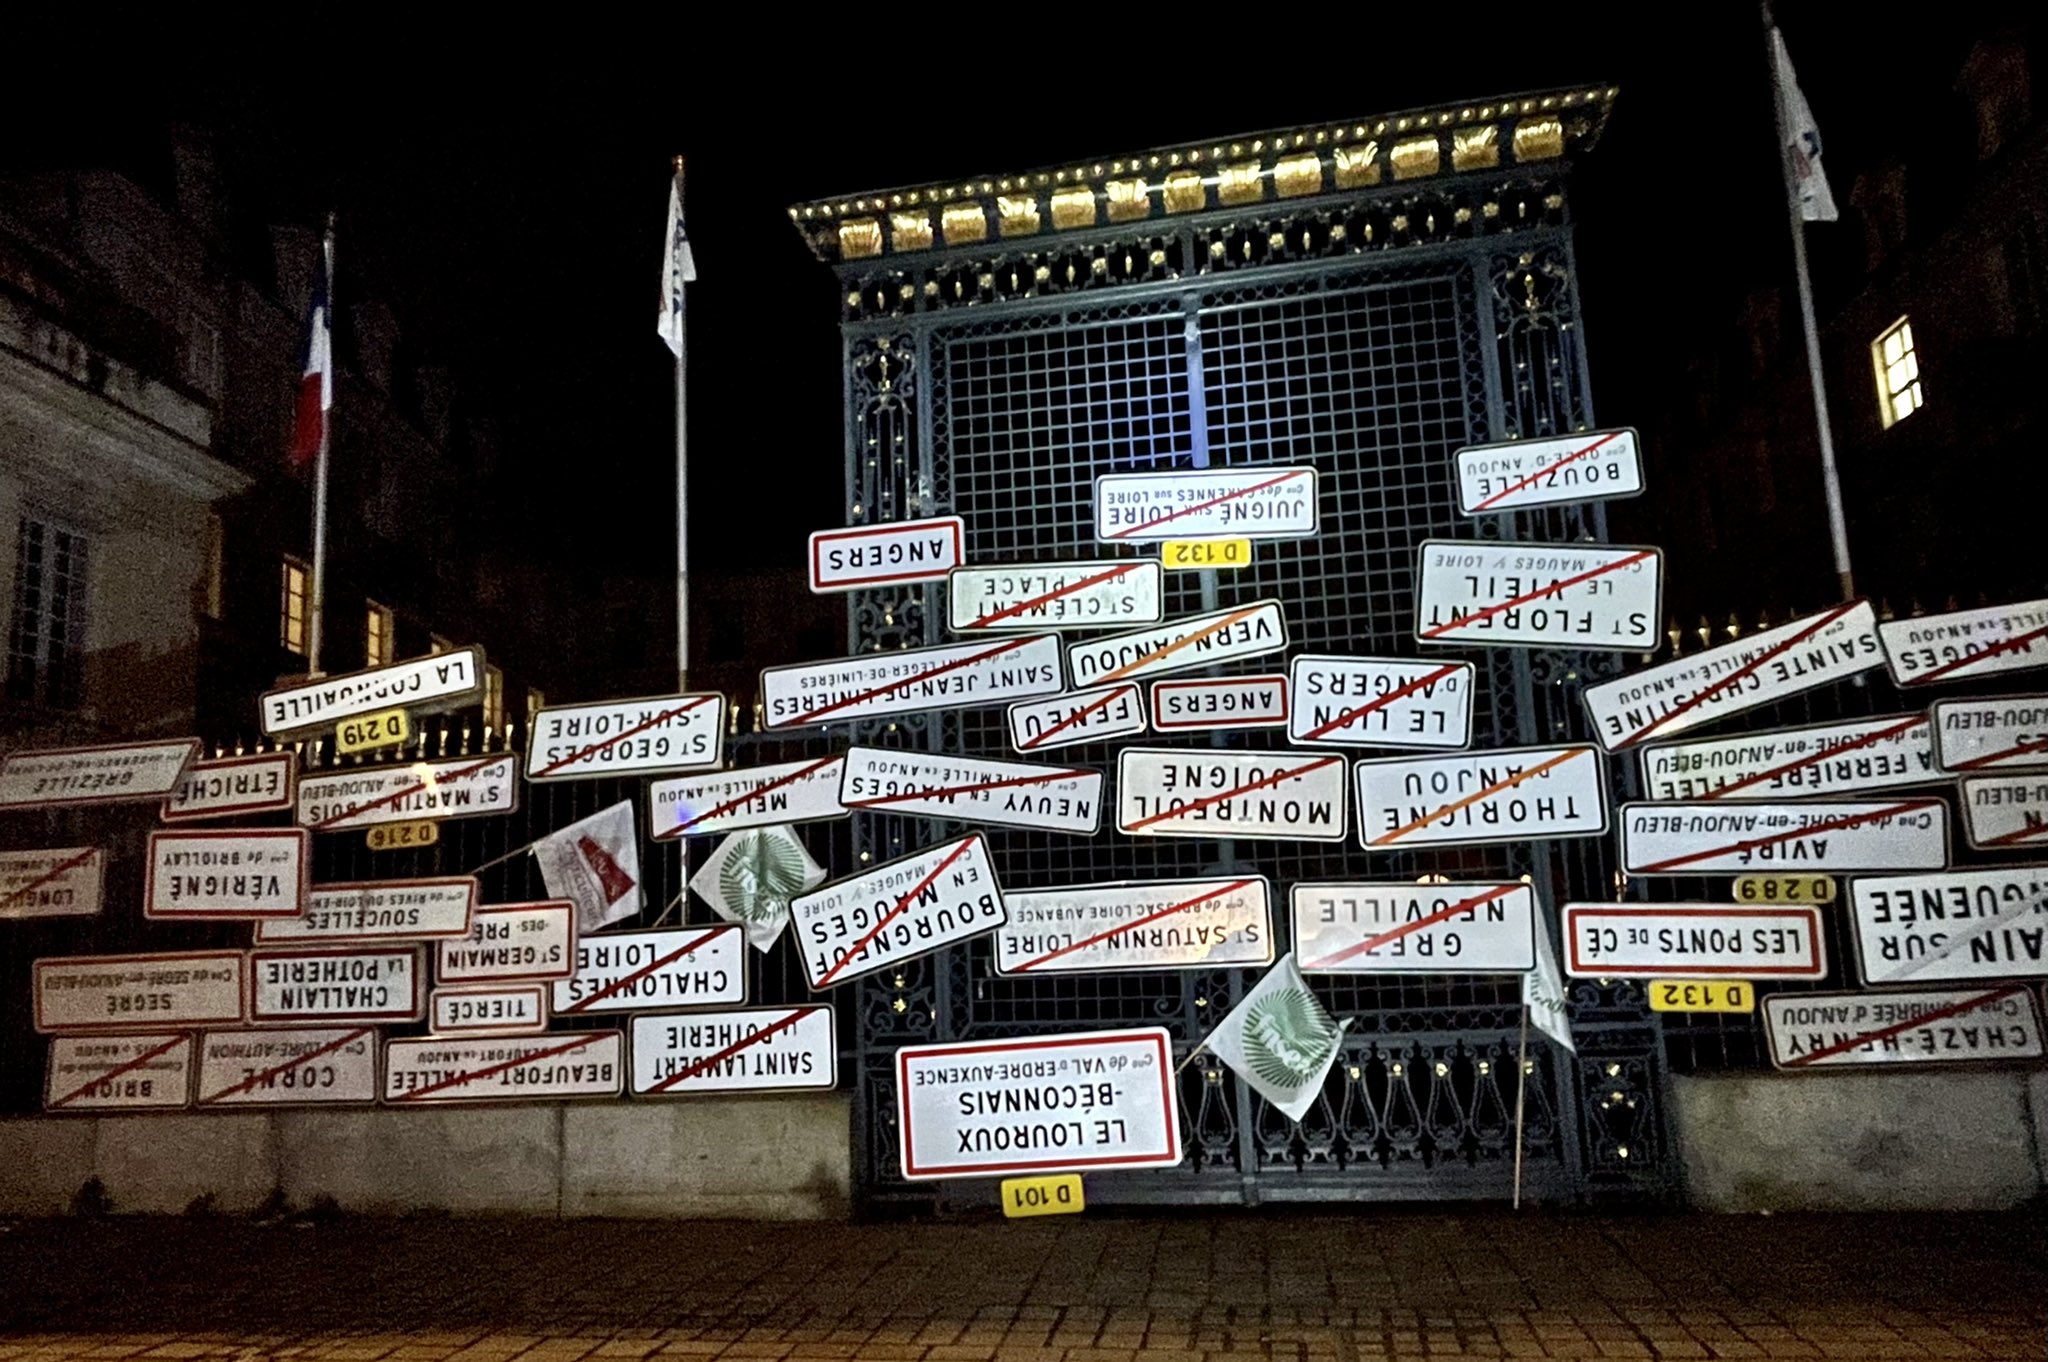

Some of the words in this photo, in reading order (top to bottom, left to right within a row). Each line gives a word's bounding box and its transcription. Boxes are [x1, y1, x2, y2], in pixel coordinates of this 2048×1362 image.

[1107, 492, 1148, 505] LOIRE
[1154, 490, 1171, 499] SUR
[1108, 505, 1175, 525] LOIRE
[1219, 500, 1304, 524] JUIGNÉ
[828, 540, 943, 571] ANGERS
[1176, 544, 1216, 562] 132
[1225, 544, 1238, 559] D
[1434, 555, 1483, 568] LOIRE
[1516, 557, 1586, 571] MAUGES
[984, 576, 1064, 596] PLACE
[1588, 581, 1612, 596] LE
[1429, 605, 1592, 632] FLORENT
[1196, 616, 1273, 653] VERN
[1770, 634, 1877, 683] SAINTE
[436, 661, 465, 685] LA
[989, 664, 1054, 690] SAINT
[1169, 690, 1273, 715] ANGERS
[1605, 673, 1762, 736] CHRISTINE
[387, 716, 400, 736] D
[1026, 698, 1130, 738] FENEU
[1315, 705, 1389, 731] LION
[1410, 710, 1446, 734] LE
[344, 721, 380, 746] 219
[547, 737, 670, 766] GEORGES
[391, 789, 471, 814] MARTIN
[851, 777, 955, 804] MAUGES
[969, 789, 989, 801] EN
[712, 792, 788, 820] MELAY
[1003, 793, 1090, 819] NEUVY
[1133, 797, 1331, 825] MONTREUIL
[372, 827, 412, 847] 216
[418, 825, 431, 841] D
[163, 852, 240, 866] BRIOLLAY
[1737, 840, 1829, 865] AVIRÉ
[169, 875, 279, 901] VÉRIGNÉ
[952, 867, 979, 888] EN
[1740, 880, 1800, 900] 289
[1812, 880, 1828, 900] D
[803, 894, 843, 918] LOIRE
[811, 882, 939, 944] MAUGES
[1016, 908, 1085, 923] AUBANCE
[1090, 905, 1133, 920] LOIRE
[1204, 900, 1221, 912] de
[1319, 899, 1505, 923] NEUVILLE
[305, 908, 420, 930] SOUCELLES
[816, 894, 996, 975] BOURGNEUF
[1006, 934, 1073, 955] LOIRE
[1107, 926, 1227, 951] SATURNIN
[1363, 933, 1462, 957] GREZ
[1585, 928, 1618, 958] CÉ
[1627, 929, 1649, 944] DE
[1658, 929, 1742, 954] PONTS
[1753, 929, 1800, 954] LES
[1879, 932, 1950, 960] SUR
[388, 959, 404, 974] LA
[447, 947, 536, 970] GERMAIN
[578, 944, 657, 970] LOIRE
[266, 962, 378, 984] POTHERIE
[280, 986, 388, 1010] CHALLAIN
[568, 971, 728, 1002] CHALONNES
[1662, 985, 1714, 1006] 132
[1726, 987, 1742, 1006] D
[105, 994, 173, 1016] SEGRÉ
[448, 1000, 526, 1023] TIERCÉ
[666, 1023, 773, 1050] POTHERIE
[499, 1064, 613, 1086] BEAUFORT
[652, 1054, 746, 1080] LAMBERT
[755, 1052, 813, 1075] SAINT
[1071, 1058, 1106, 1076] VAL
[1109, 1056, 1129, 1073] de
[959, 1083, 1124, 1115] -BÉCONNAIS
[956, 1121, 1083, 1153] LOUROUX
[1094, 1120, 1126, 1145] LE
[1013, 1187, 1050, 1208] 101
[1057, 1185, 1071, 1204] D
